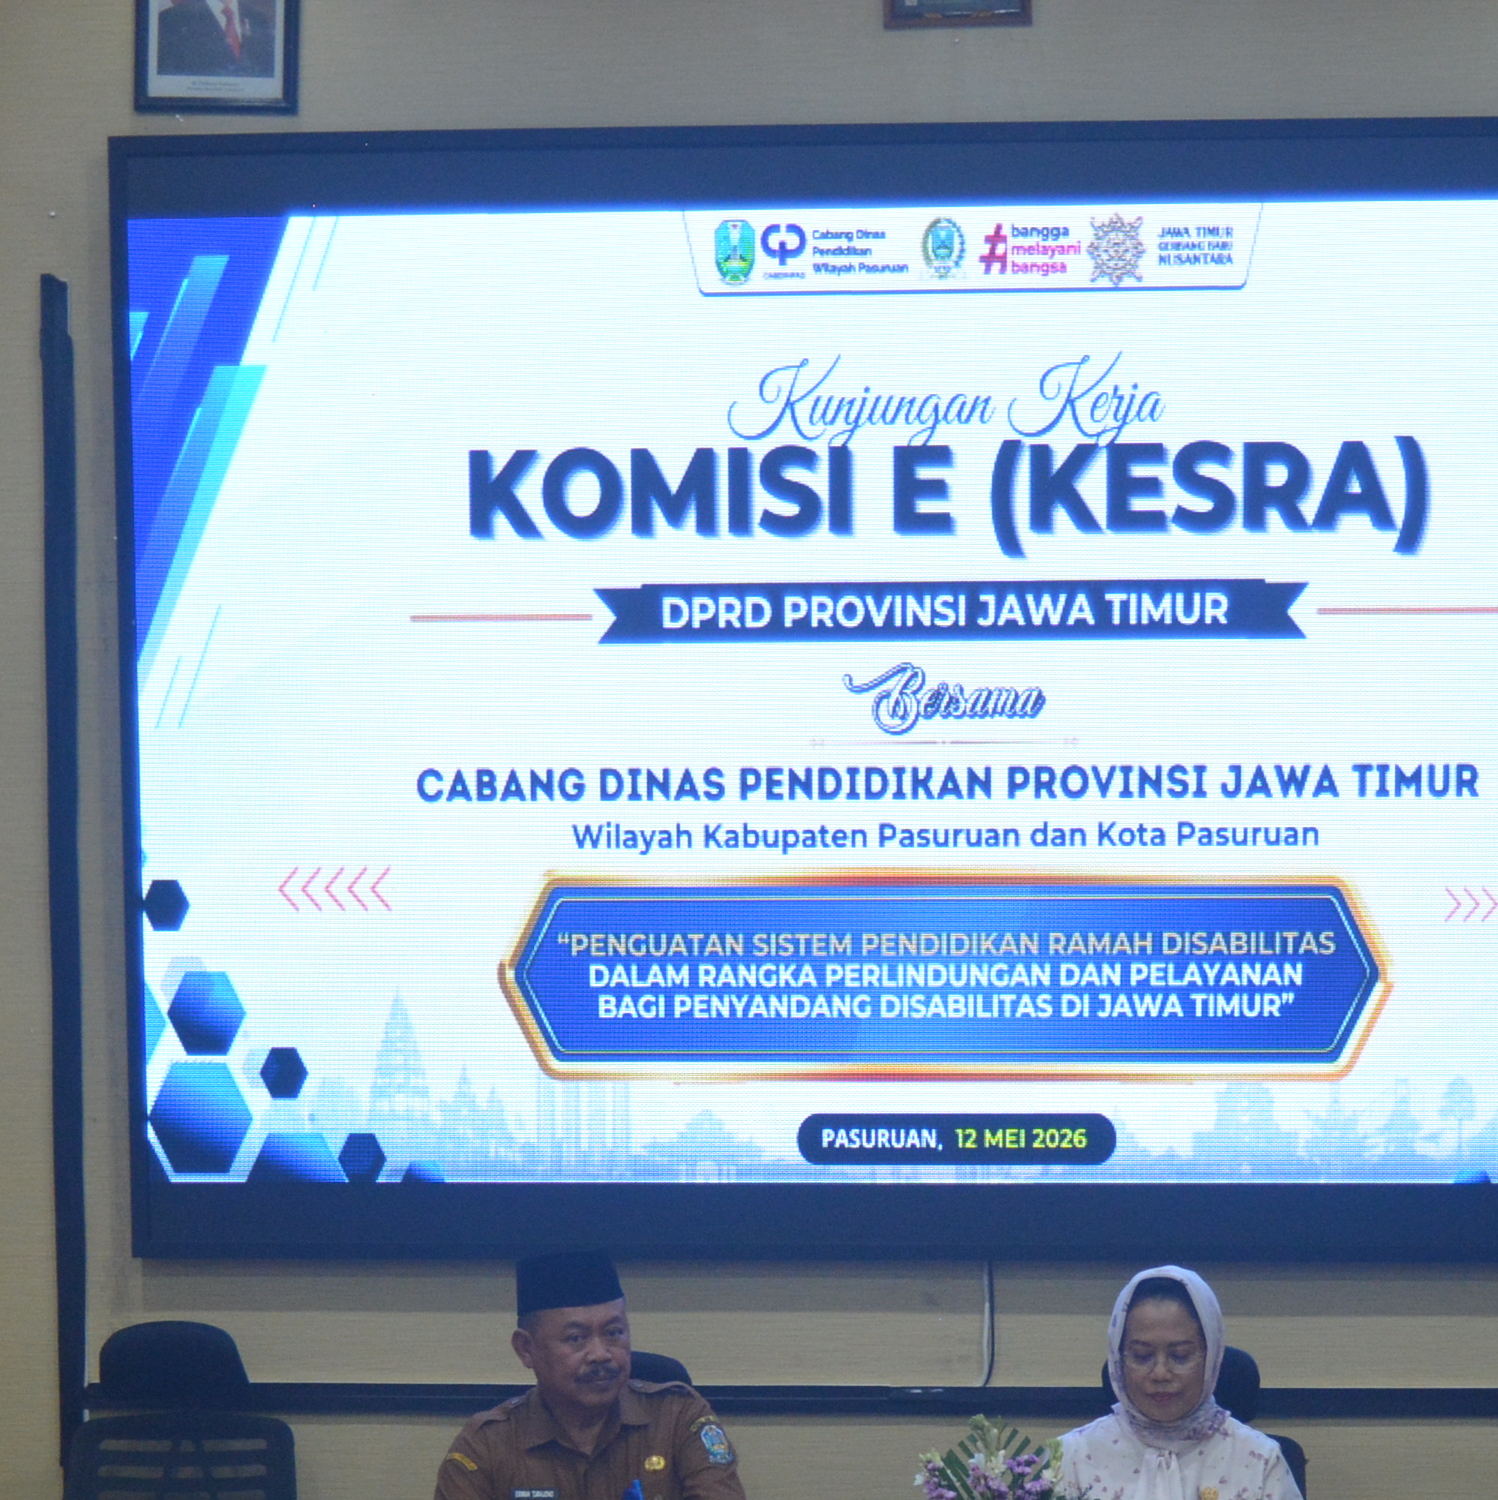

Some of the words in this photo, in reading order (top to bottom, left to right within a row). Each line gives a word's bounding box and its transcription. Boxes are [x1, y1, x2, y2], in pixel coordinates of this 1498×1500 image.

[812, 230, 854, 242] Cabang
[856, 230, 886, 240] Dinas
[1011, 224, 1070, 241] bangga
[812, 246, 872, 257] Pendidikan
[1011, 241, 1081, 259] melayani
[812, 263, 856, 276] Wilayah
[858, 263, 908, 274] Pasuruan
[1011, 261, 1067, 276] bangsa
[727, 355, 994, 444] Kunjungan
[1008, 351, 1165, 445] Kerja
[468, 446, 856, 539] KOMISI
[893, 444, 957, 538] E
[989, 434, 1430, 558] (KESRA)
[663, 597, 771, 629] DPRD
[784, 595, 966, 628] PROVINSI
[978, 594, 1094, 626] JAWA
[1105, 593, 1228, 625] TIMUR
[842, 663, 1046, 735] Bersama
[417, 768, 586, 803] CABANG
[600, 768, 725, 801] DINAS
[740, 767, 991, 801] PENDIDIKAN
[1008, 765, 1206, 799] PROVINSI
[1221, 765, 1338, 798] JAWA
[1353, 764, 1478, 798] TIMUR
[573, 823, 693, 856] Wilayah
[704, 824, 867, 855] Kabupaten
[879, 823, 1020, 848] Pasuruan
[1030, 822, 1087, 847] dan
[1098, 823, 1166, 847] Kota
[1177, 821, 1319, 847] Pasuruan
[558, 933, 744, 957] “PENGUATAN
[754, 933, 852, 957] SISTEM
[862, 933, 1038, 956] PENDIDIKAN
[1049, 932, 1152, 954] RAMAH
[1162, 931, 1335, 955] DISABILITAS
[590, 965, 689, 988] DALAM
[699, 964, 817, 988] RANGKA
[826, 963, 1050, 987] PERLINDUNGAN
[1060, 964, 1121, 987] DAN
[1130, 963, 1302, 986] PELAYANAN
[599, 993, 665, 1019] BAGI
[674, 993, 871, 1019] PENYANDANG
[881, 993, 1052, 1019] DISABILITAS
[1061, 993, 1089, 1018] DI
[1098, 994, 1182, 1018] JAWA
[1191, 993, 1294, 1017] TIMUR”
[822, 1129, 941, 1152] PASURUAN,
[956, 1128, 977, 1149] 12
[984, 1129, 1025, 1149] MEI
[1033, 1129, 1087, 1149] 2026
